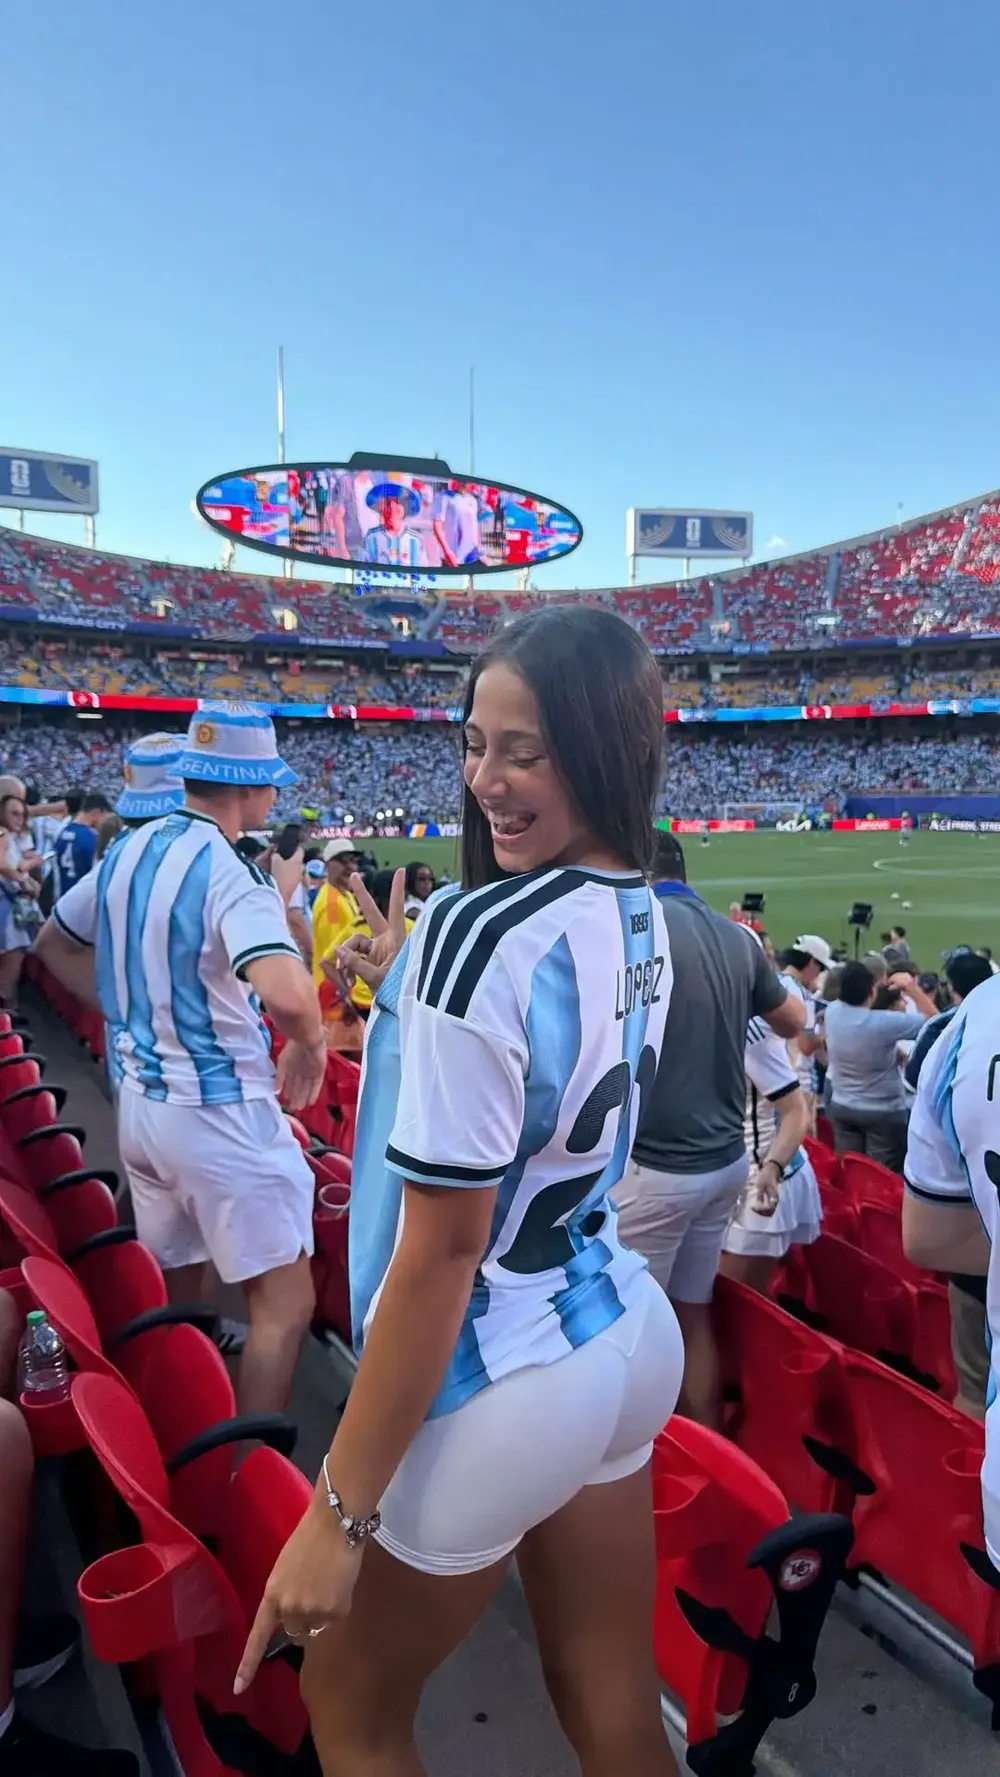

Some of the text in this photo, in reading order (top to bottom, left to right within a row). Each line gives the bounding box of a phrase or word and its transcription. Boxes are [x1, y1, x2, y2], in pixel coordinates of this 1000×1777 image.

[60, 842, 76, 878] 4
[630, 911, 650, 936] 1893
[614, 954, 665, 1022] LOPEZ
